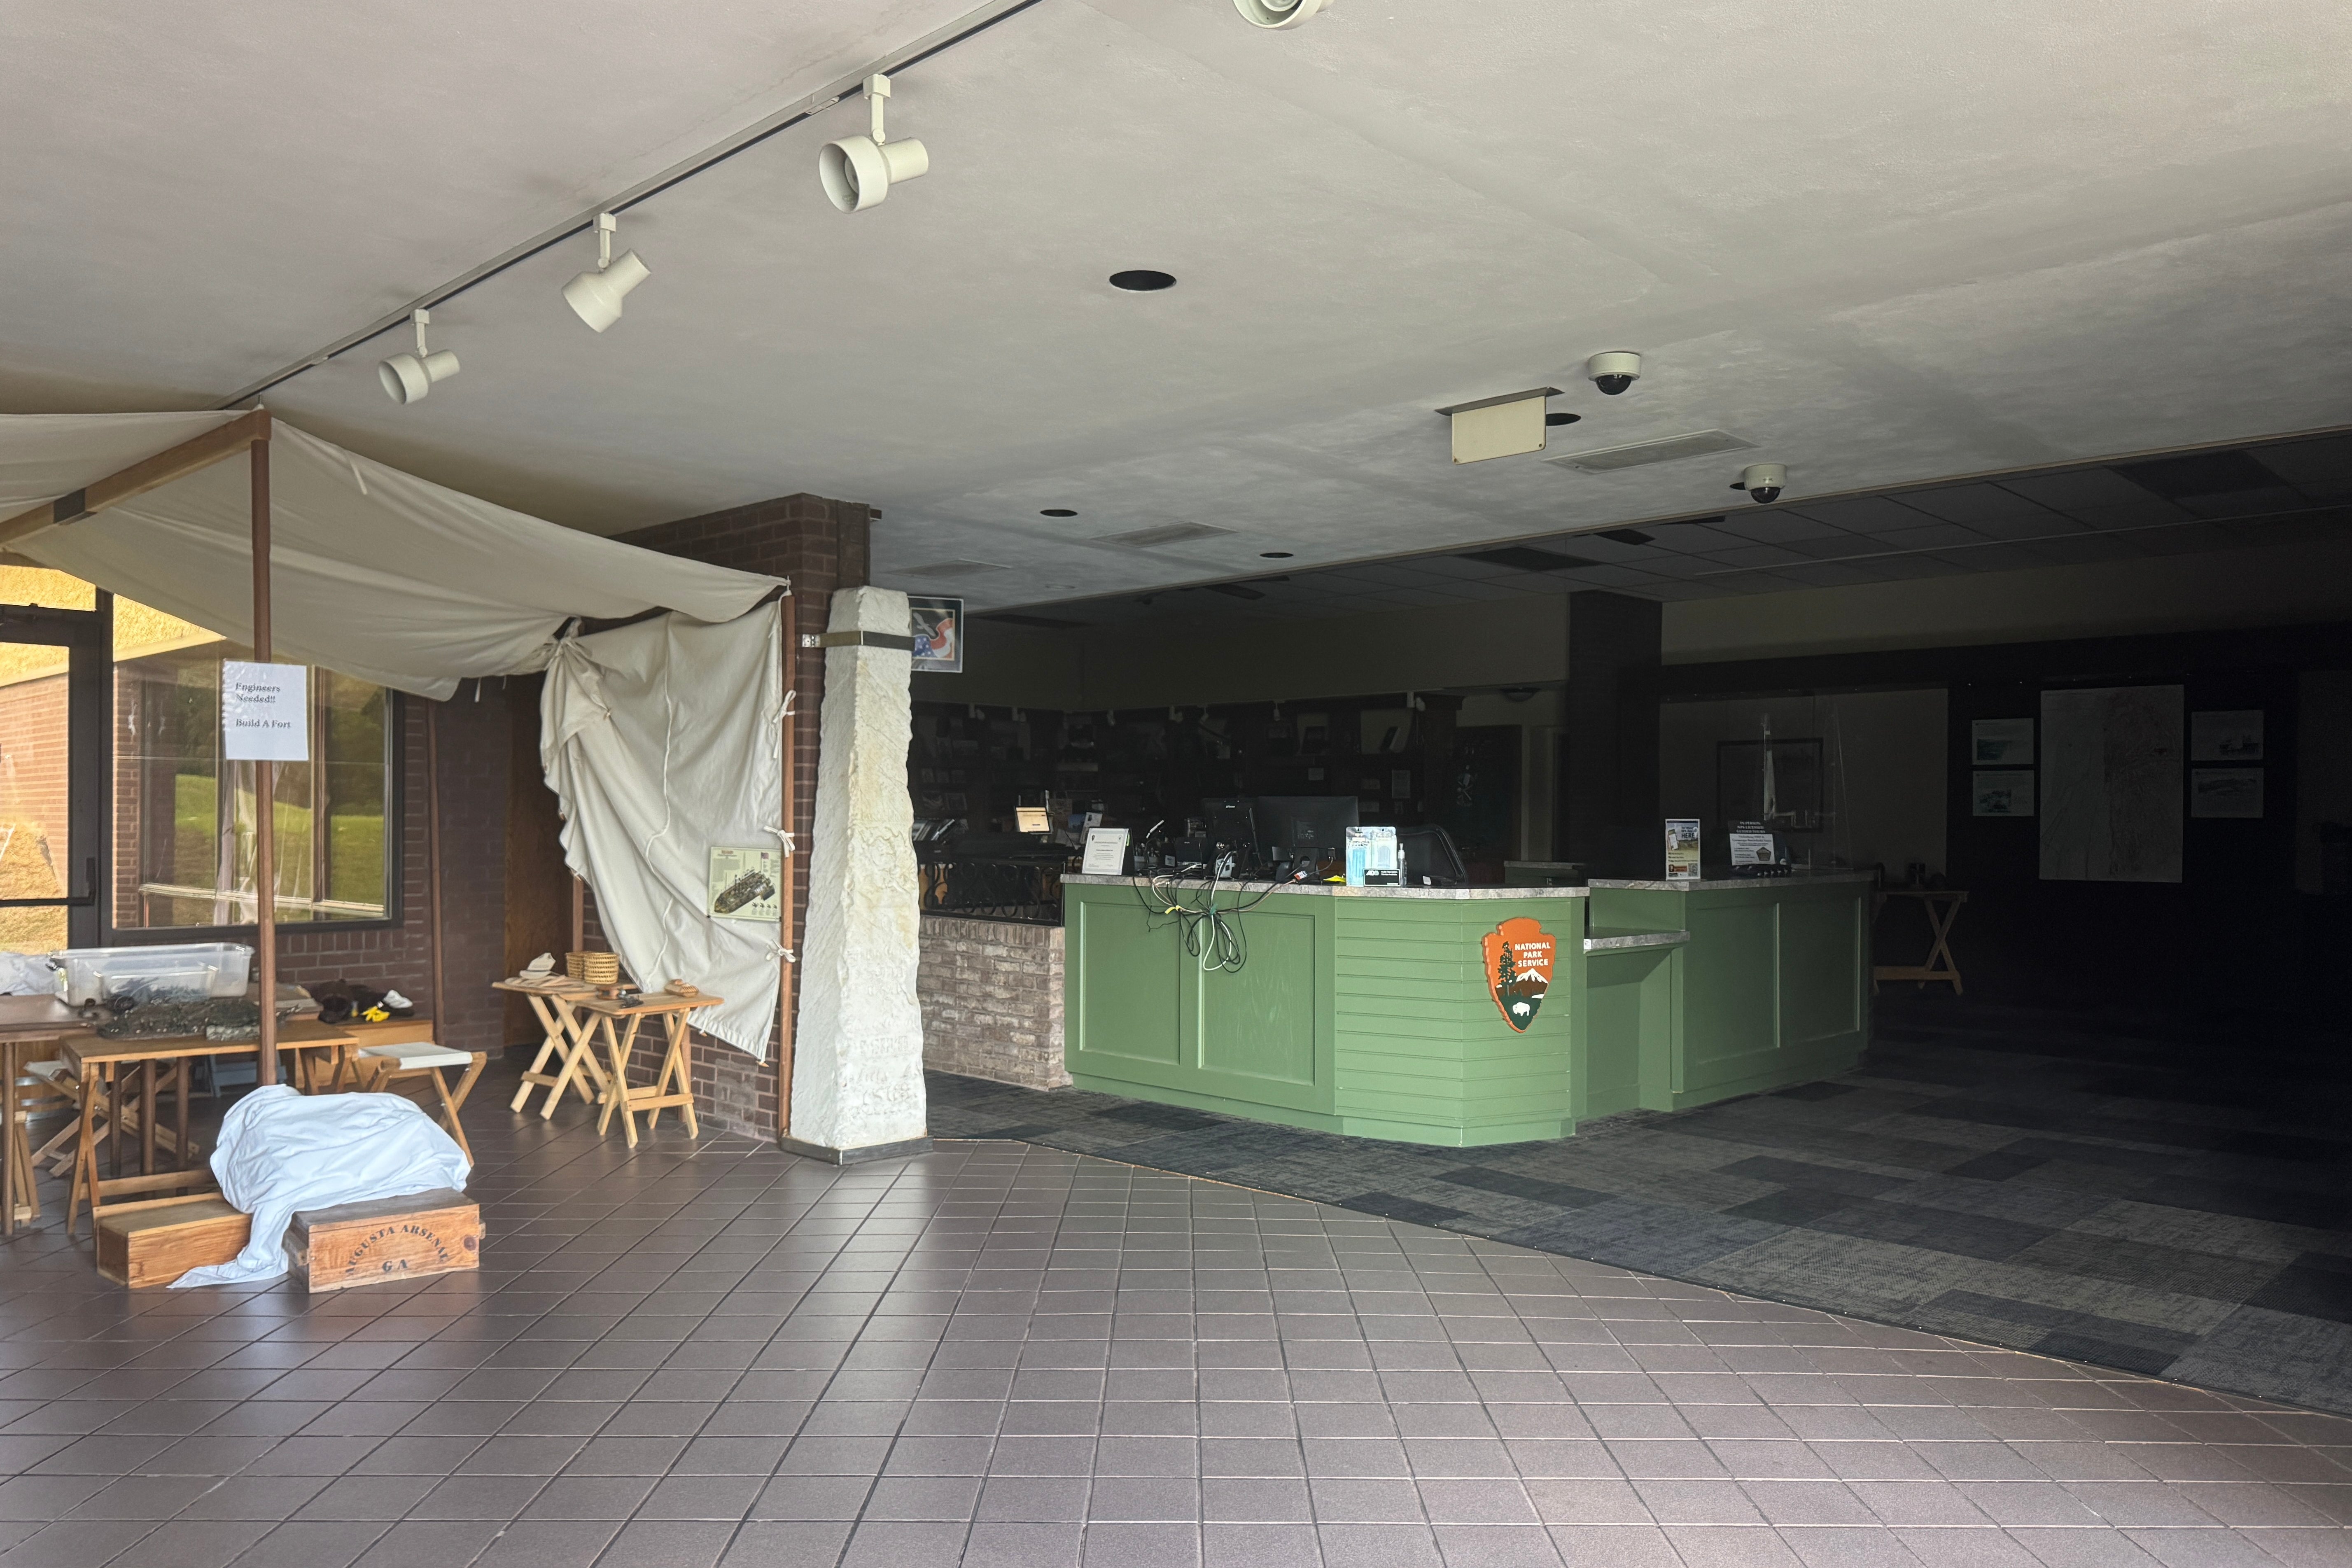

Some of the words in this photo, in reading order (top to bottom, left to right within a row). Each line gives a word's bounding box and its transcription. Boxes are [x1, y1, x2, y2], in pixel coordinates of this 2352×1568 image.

[236, 682, 280, 693] Engineers
[236, 693, 276, 703] Needed!!
[236, 719, 260, 728] Build
[271, 720, 291, 729] Fort
[345, 1226, 395, 1273] AUGUSTA
[401, 1225, 448, 1262] ARSENAL
